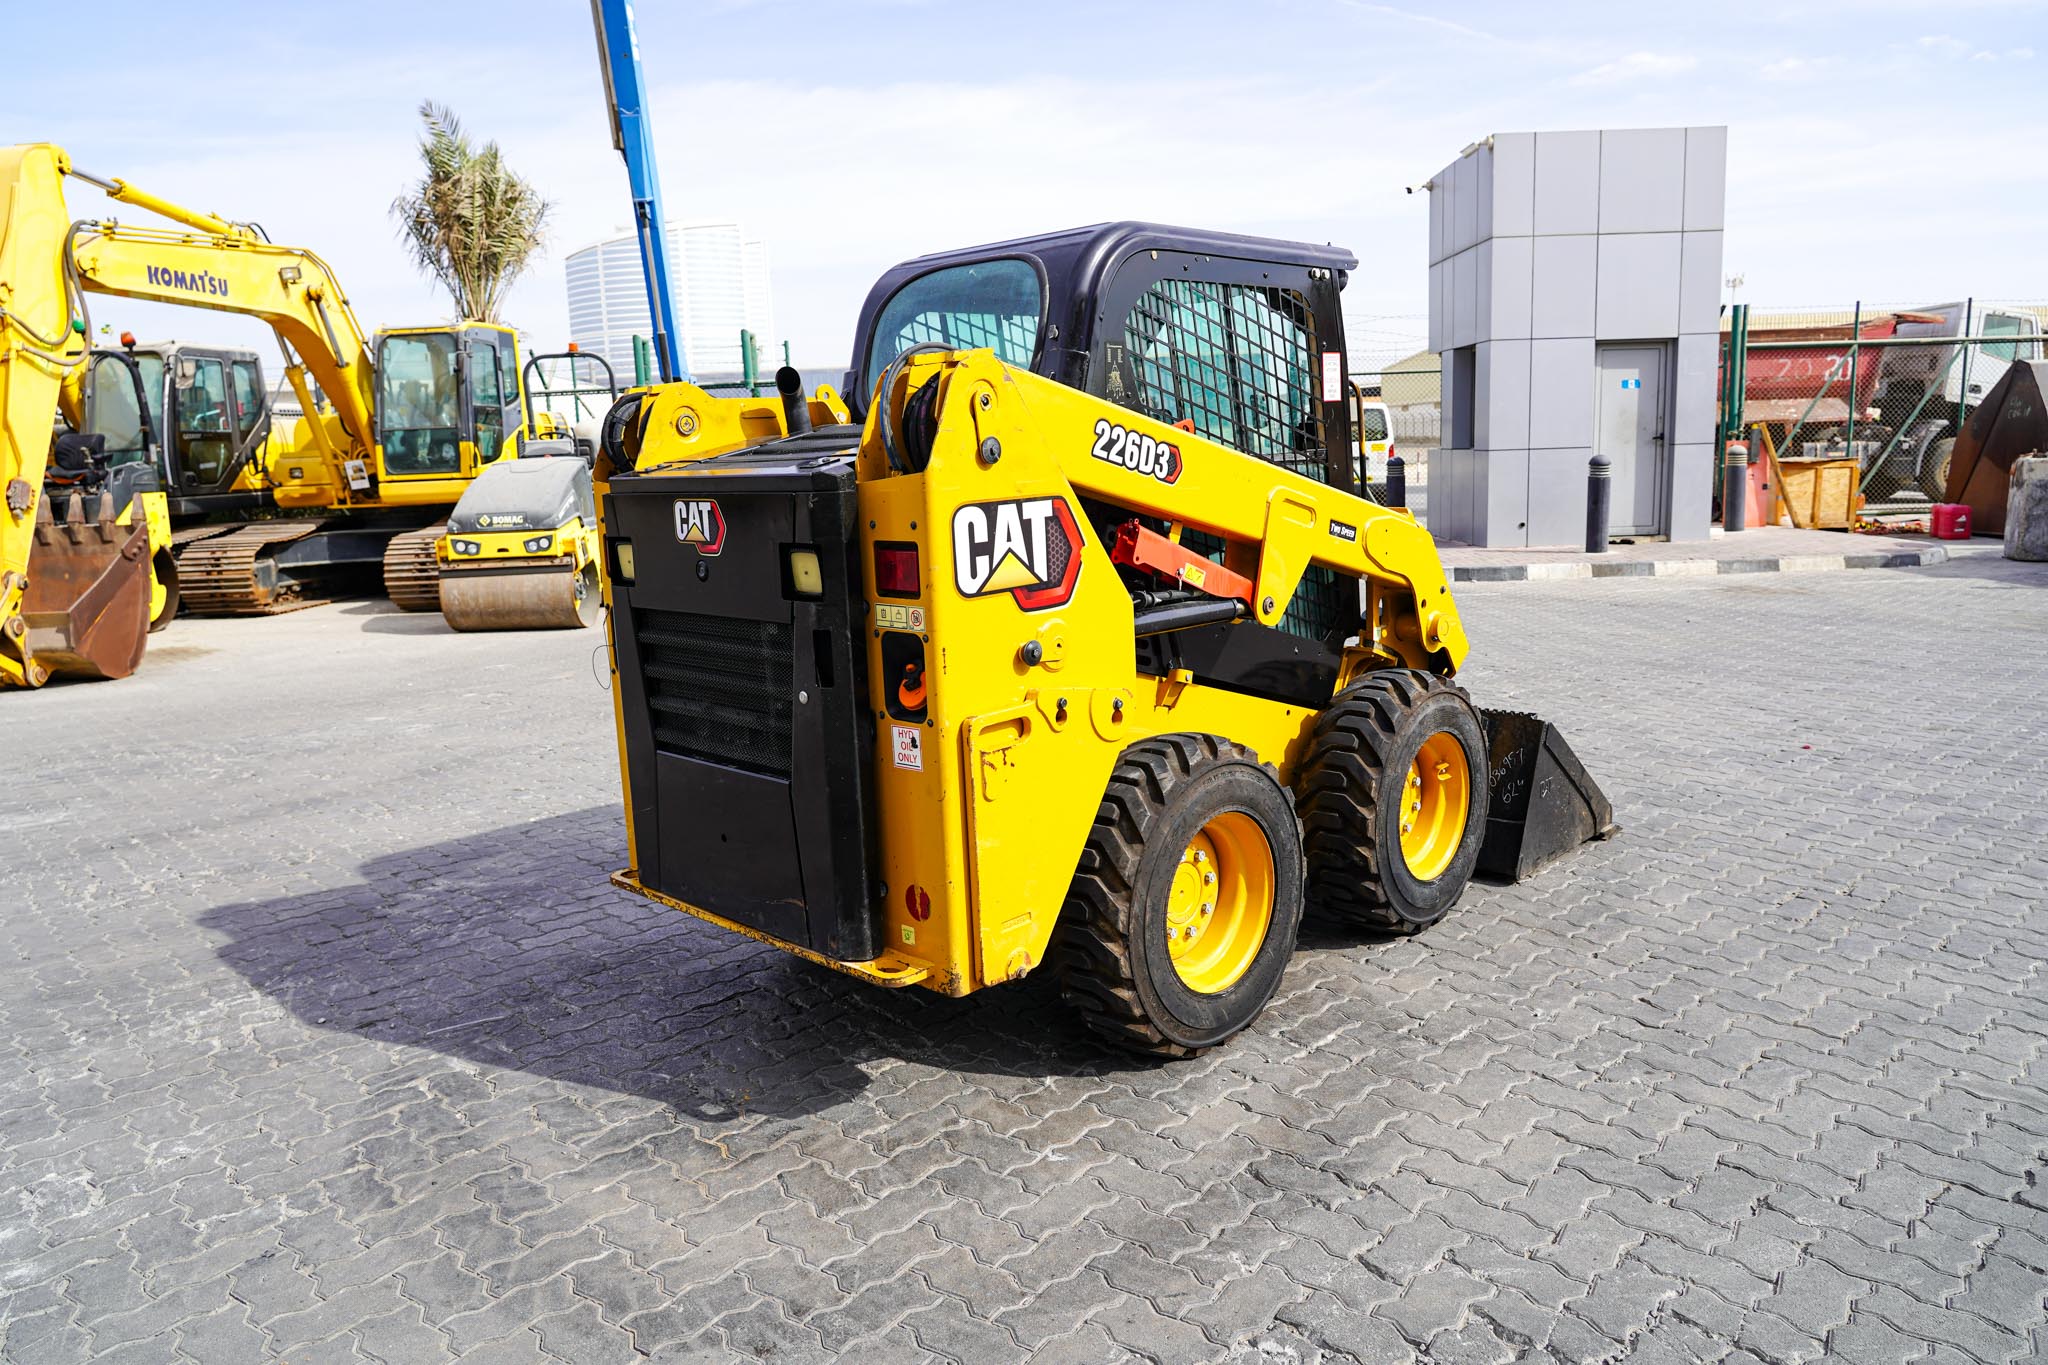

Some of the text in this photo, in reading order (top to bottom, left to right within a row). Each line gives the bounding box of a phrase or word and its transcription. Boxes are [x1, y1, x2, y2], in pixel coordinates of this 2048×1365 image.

[147, 265, 228, 297] KOMATSU
[1092, 420, 1170, 480] 226D3
[492, 516, 524, 525] BOMAG
[674, 501, 711, 541] CAT
[953, 500, 1053, 595] CAT
[898, 729, 914, 740] HYD
[901, 741, 914, 752] OIL
[897, 752, 918, 764] ONLY
